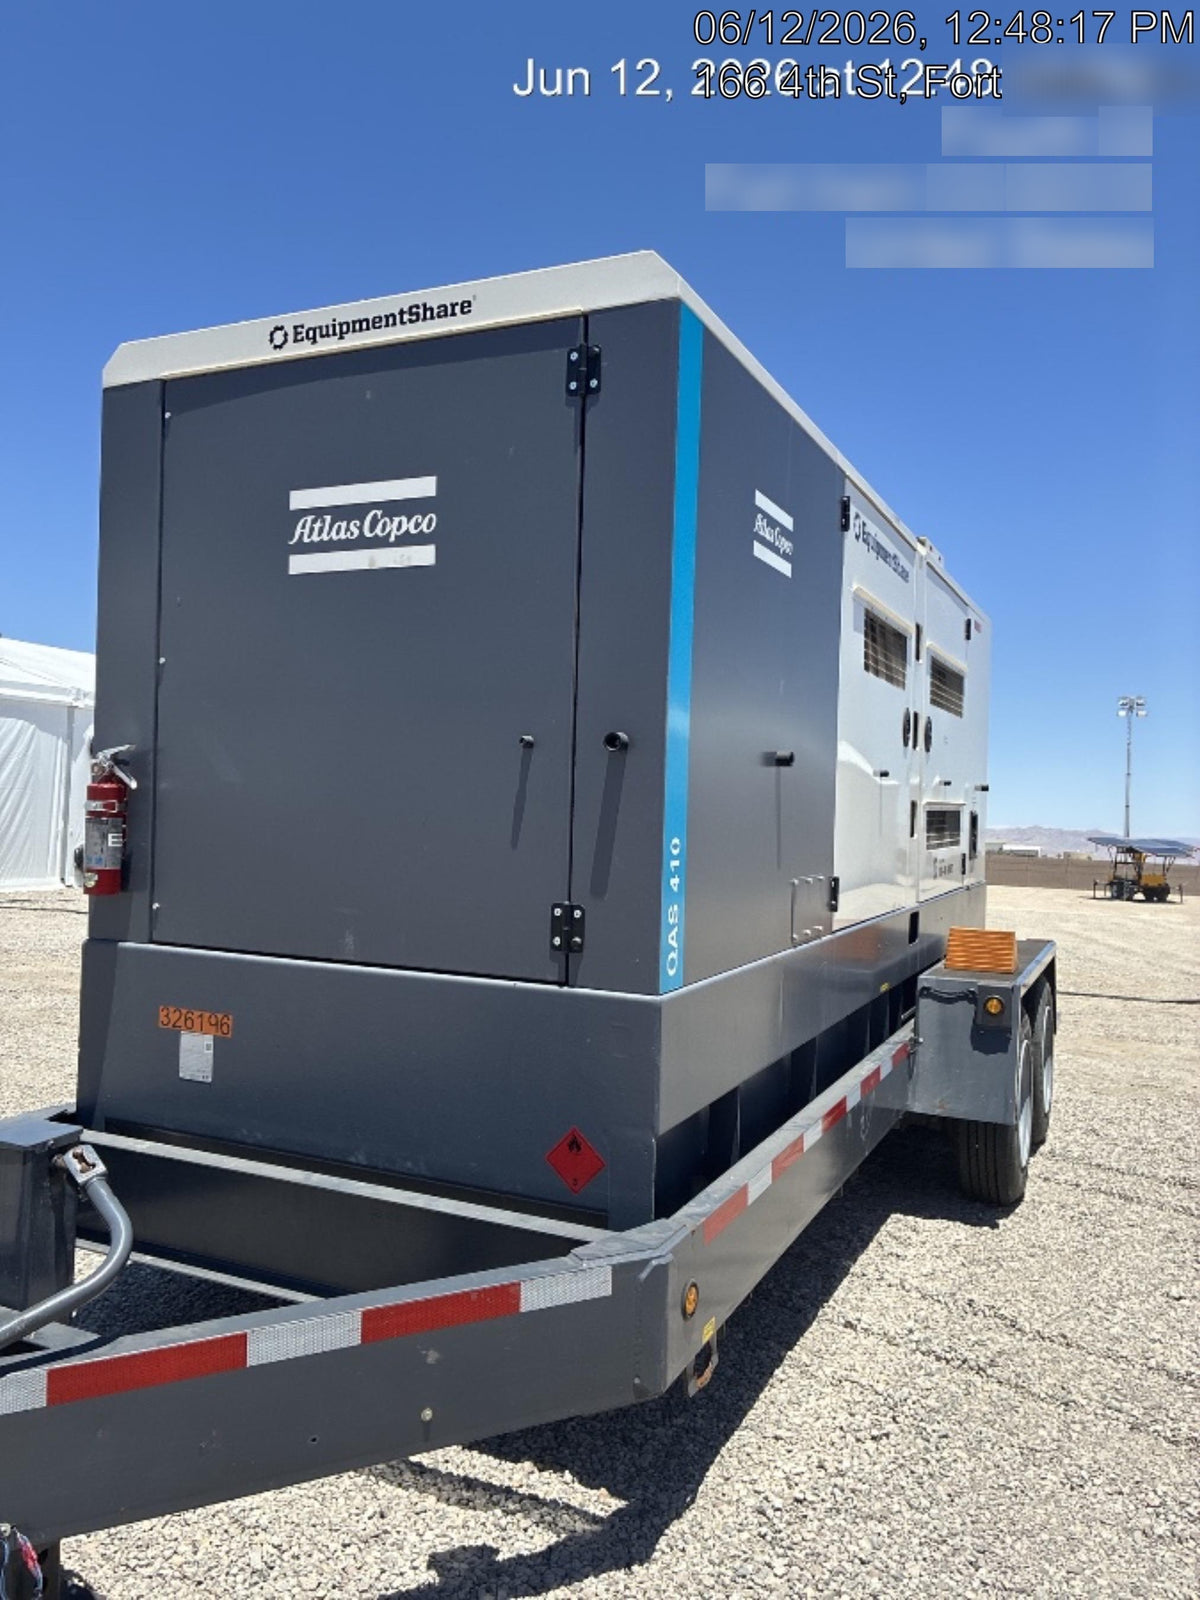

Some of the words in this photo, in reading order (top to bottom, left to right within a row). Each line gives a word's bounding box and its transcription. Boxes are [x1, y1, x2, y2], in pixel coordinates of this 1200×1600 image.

[292, 299, 473, 345] EquipmentShare
[288, 515, 360, 544] Atlas
[363, 510, 436, 542] Copco
[669, 837, 682, 892] 410
[666, 904, 679, 977] QAS
[160, 1007, 230, 1035] 326196
